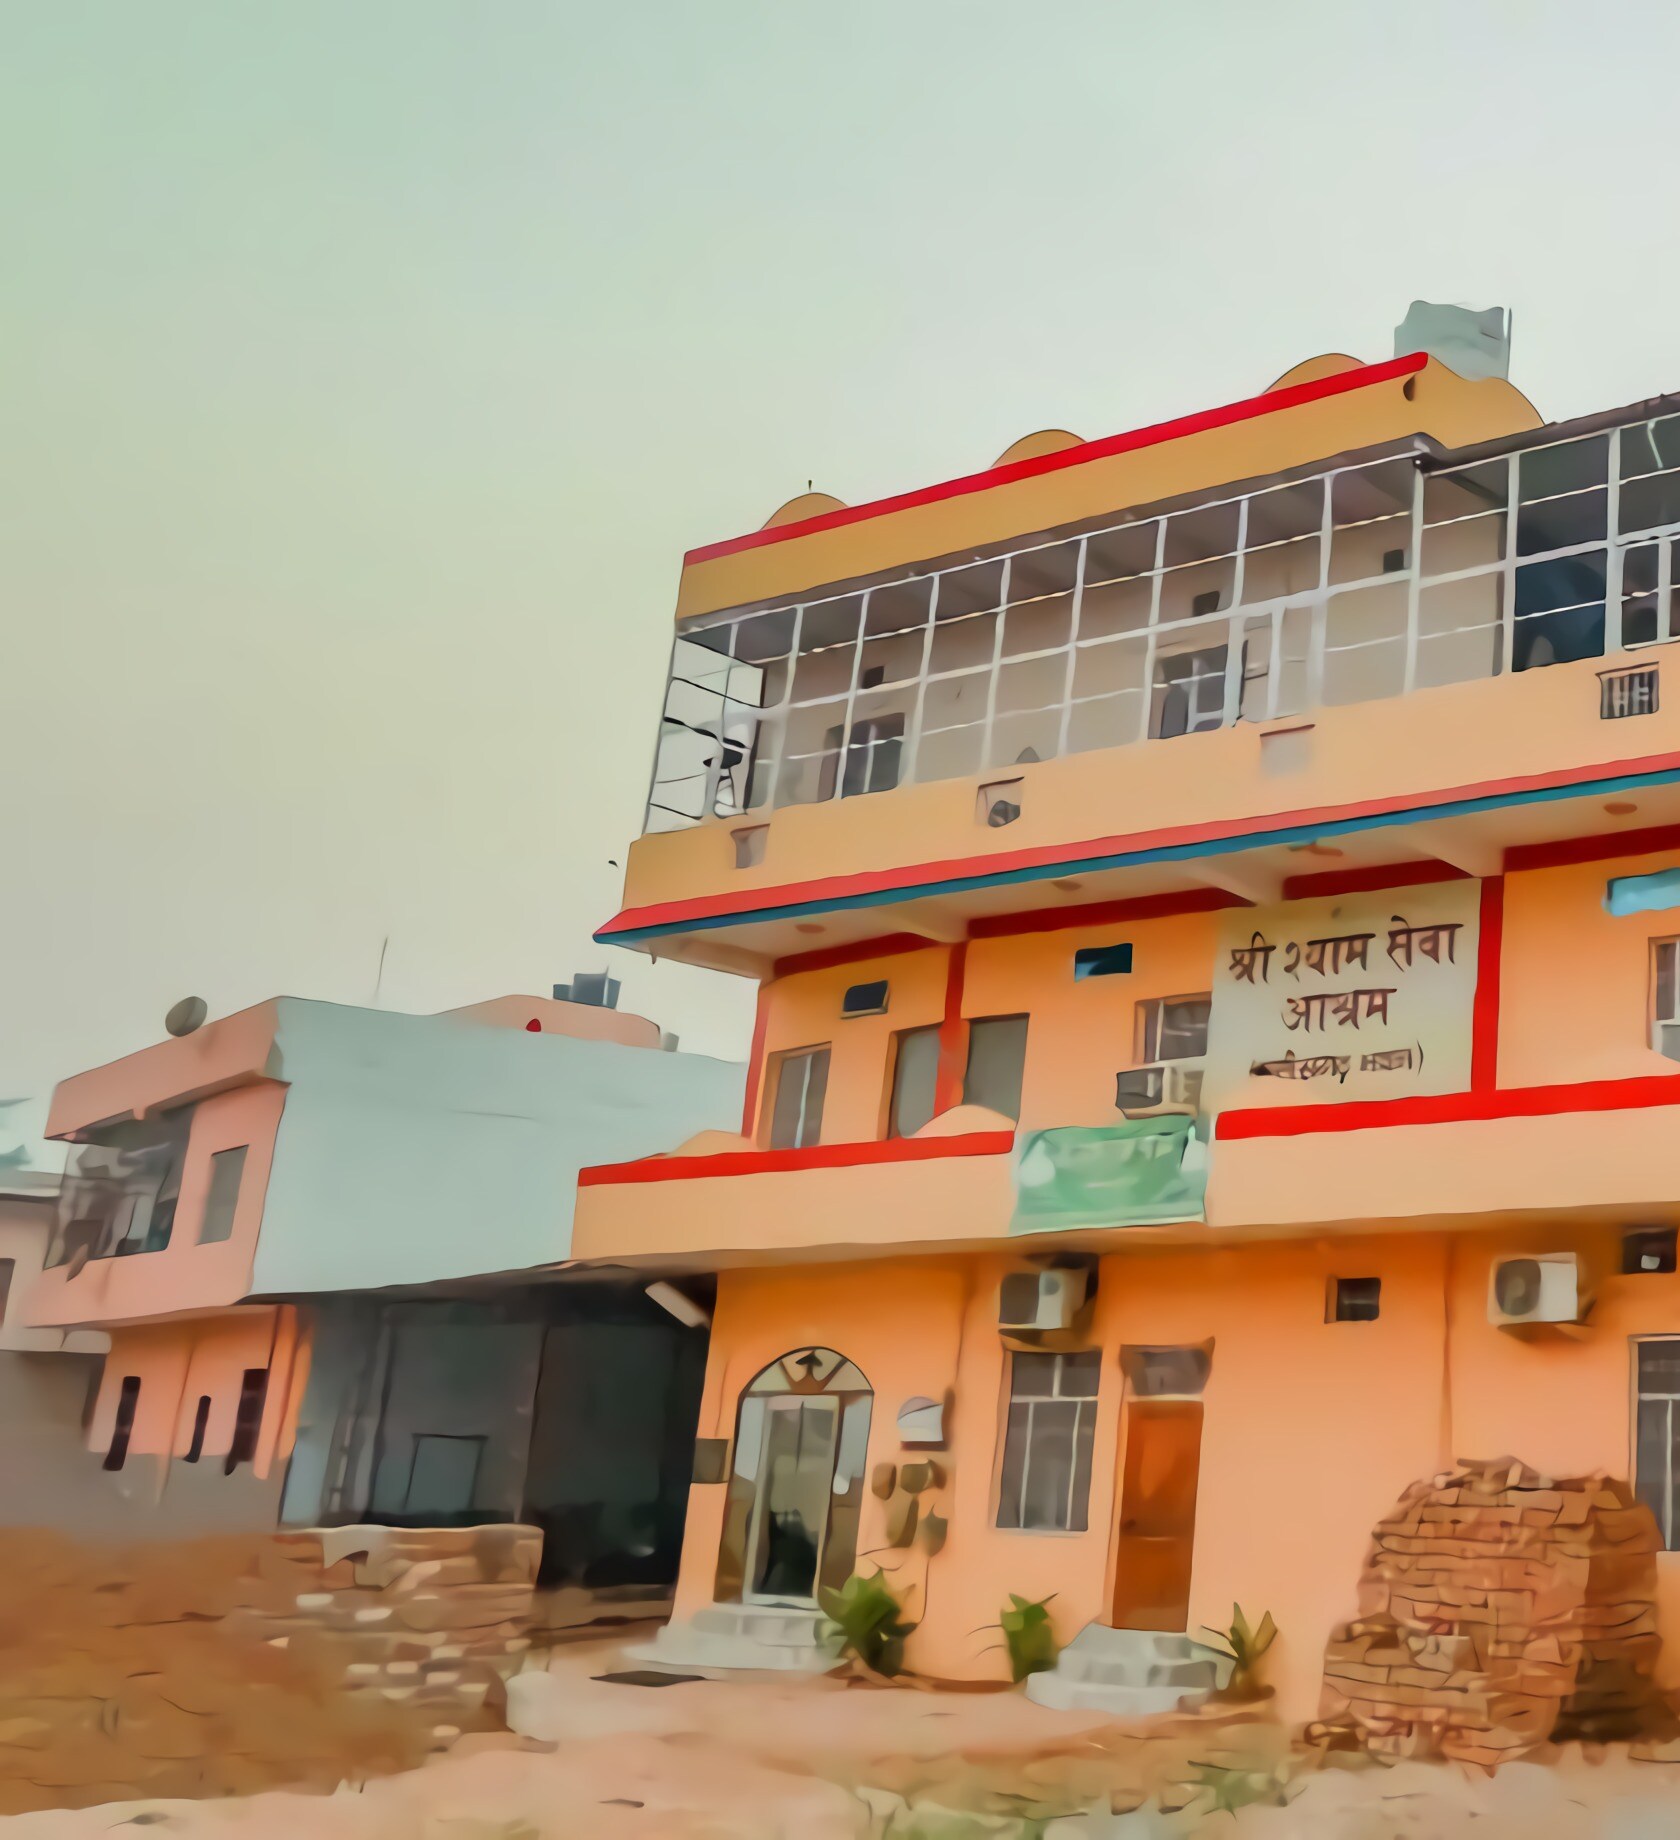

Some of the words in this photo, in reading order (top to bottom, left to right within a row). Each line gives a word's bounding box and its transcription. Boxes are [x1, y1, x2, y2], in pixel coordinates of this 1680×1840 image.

[1229, 931, 1276, 984] श्री
[1284, 933, 1376, 982] श्याम
[1386, 915, 1464, 972] सेवा
[1281, 988, 1397, 1033] आश्रम
